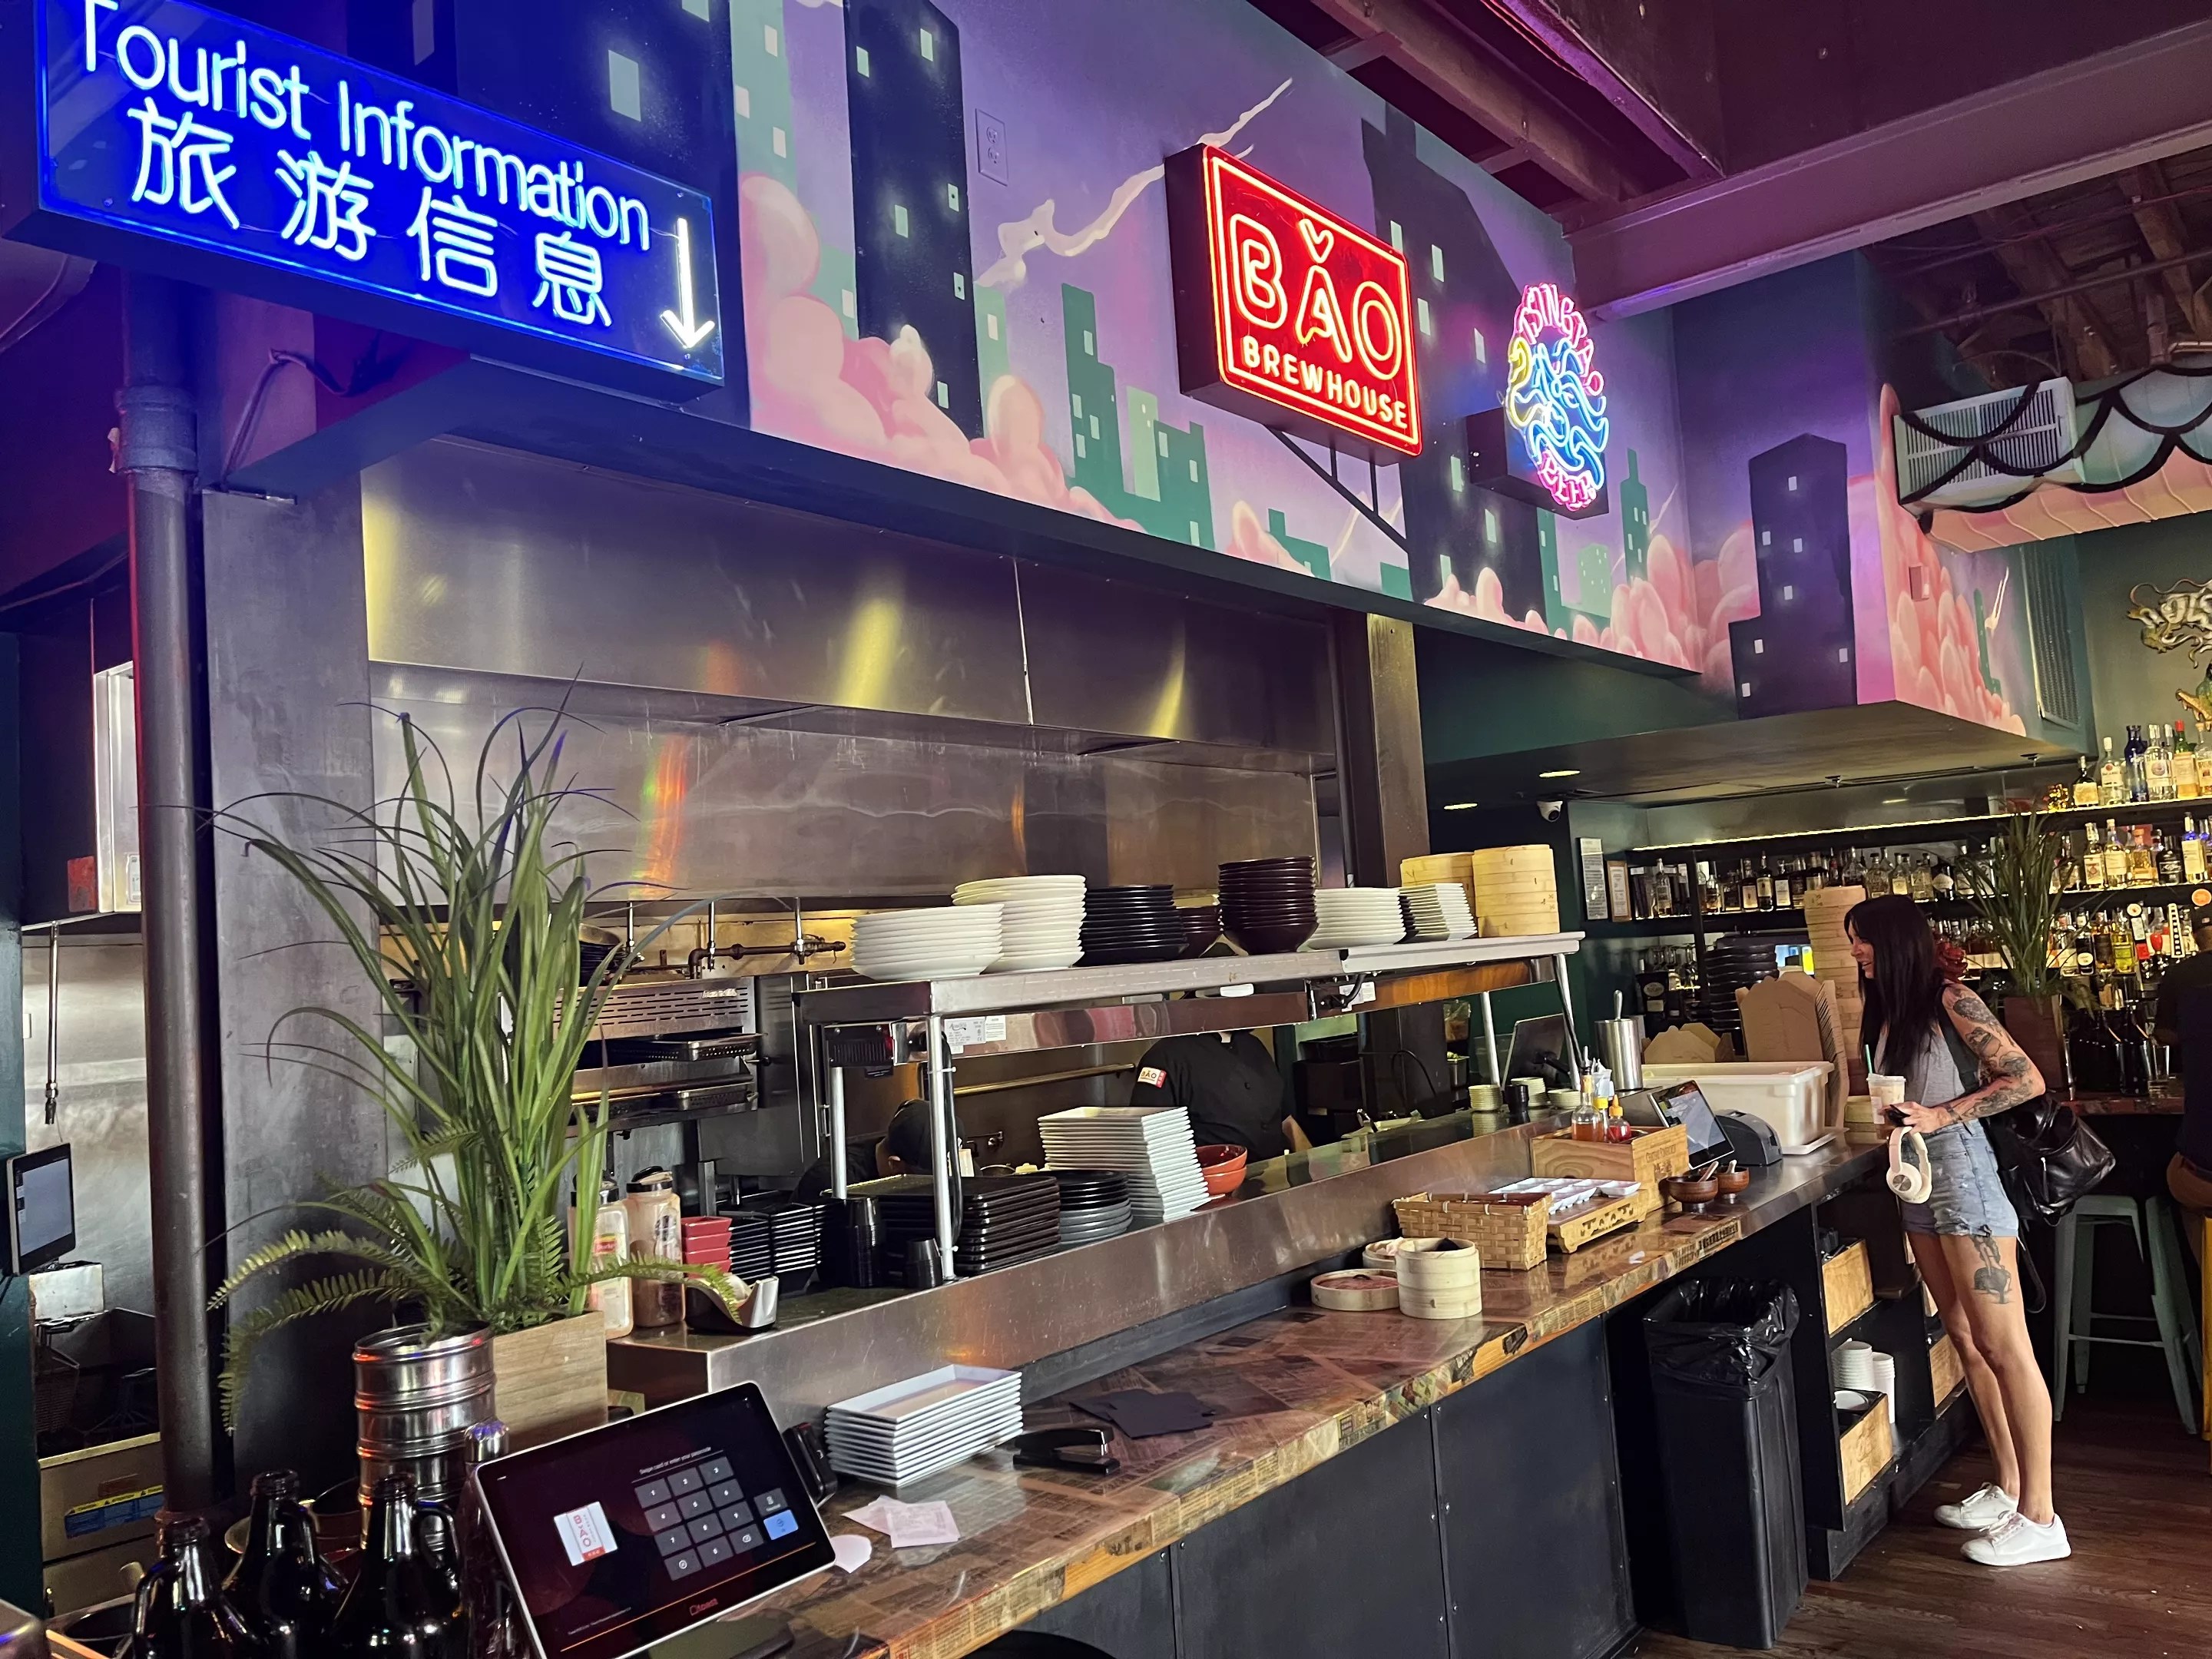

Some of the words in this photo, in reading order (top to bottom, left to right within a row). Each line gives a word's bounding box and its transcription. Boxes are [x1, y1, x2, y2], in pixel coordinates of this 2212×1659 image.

[84, 0, 312, 140] Tourist
[337, 80, 651, 252] Information
[127, 96, 613, 327] 旅游信息
[1240, 336, 1409, 429] BREWHOUSE
